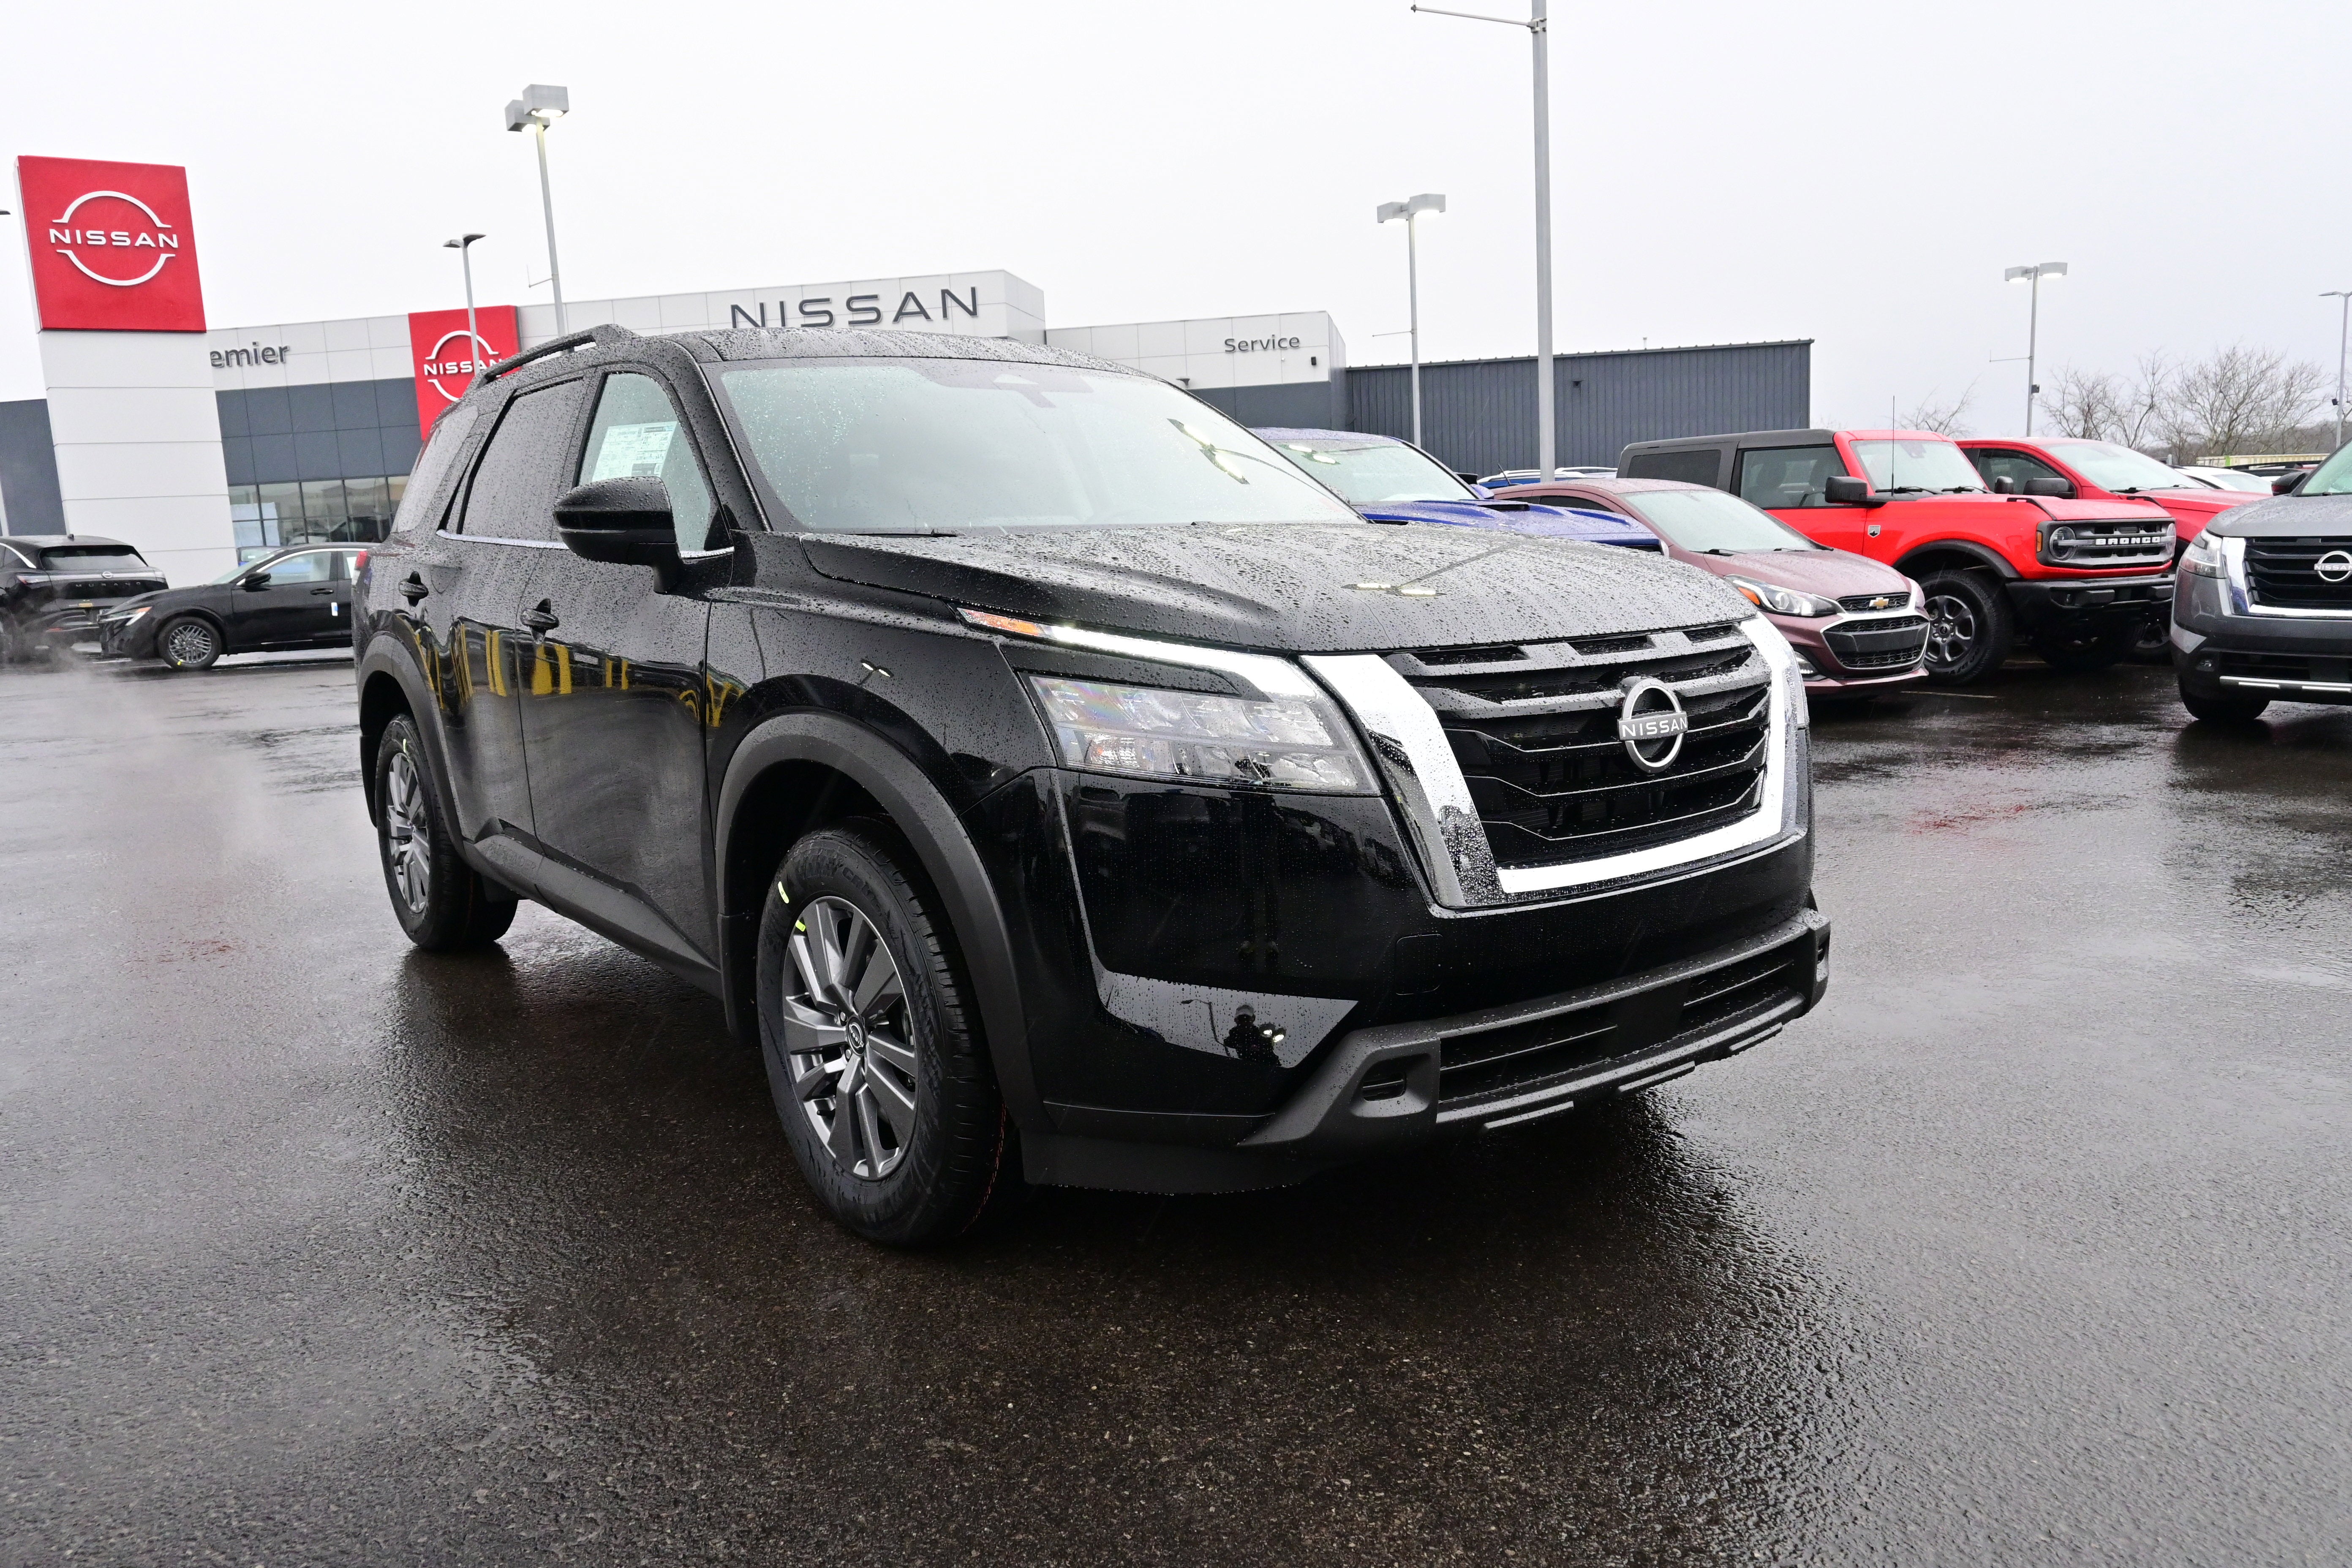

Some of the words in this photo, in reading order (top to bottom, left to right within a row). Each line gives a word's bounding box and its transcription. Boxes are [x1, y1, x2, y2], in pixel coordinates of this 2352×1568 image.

[49, 229, 179, 248] NISSAN
[730, 286, 978, 328] NISSAN
[1224, 334, 1300, 353] Service
[2095, 536, 2161, 545] BRONCO
[1622, 716, 1688, 737] NISSAN
